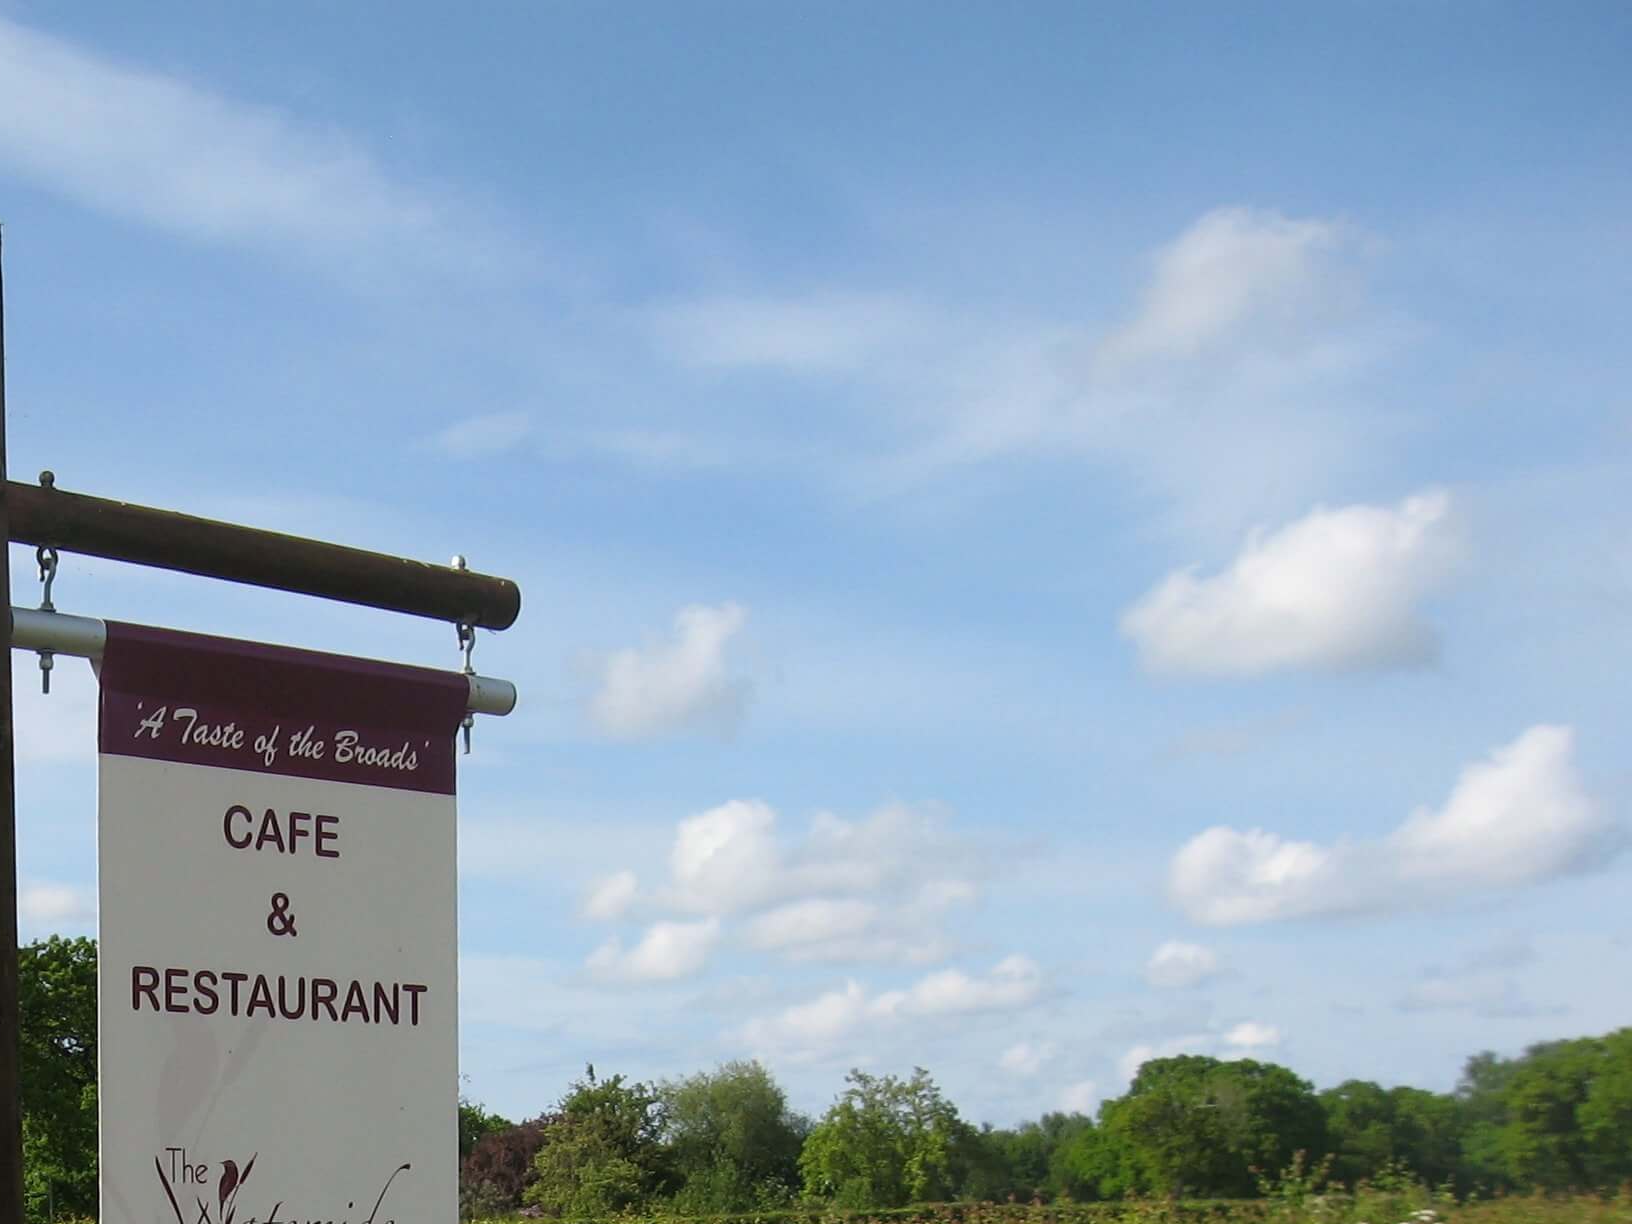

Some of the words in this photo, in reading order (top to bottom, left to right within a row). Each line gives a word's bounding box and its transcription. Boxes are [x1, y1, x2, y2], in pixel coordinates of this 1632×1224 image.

[173, 708, 244, 750] Taste
[254, 725, 279, 767] of
[288, 726, 324, 760] the
[223, 805, 340, 858] CAFE
[267, 892, 297, 937] &
[131, 965, 428, 1026] RESTAURANT
[165, 1147, 208, 1184] The
